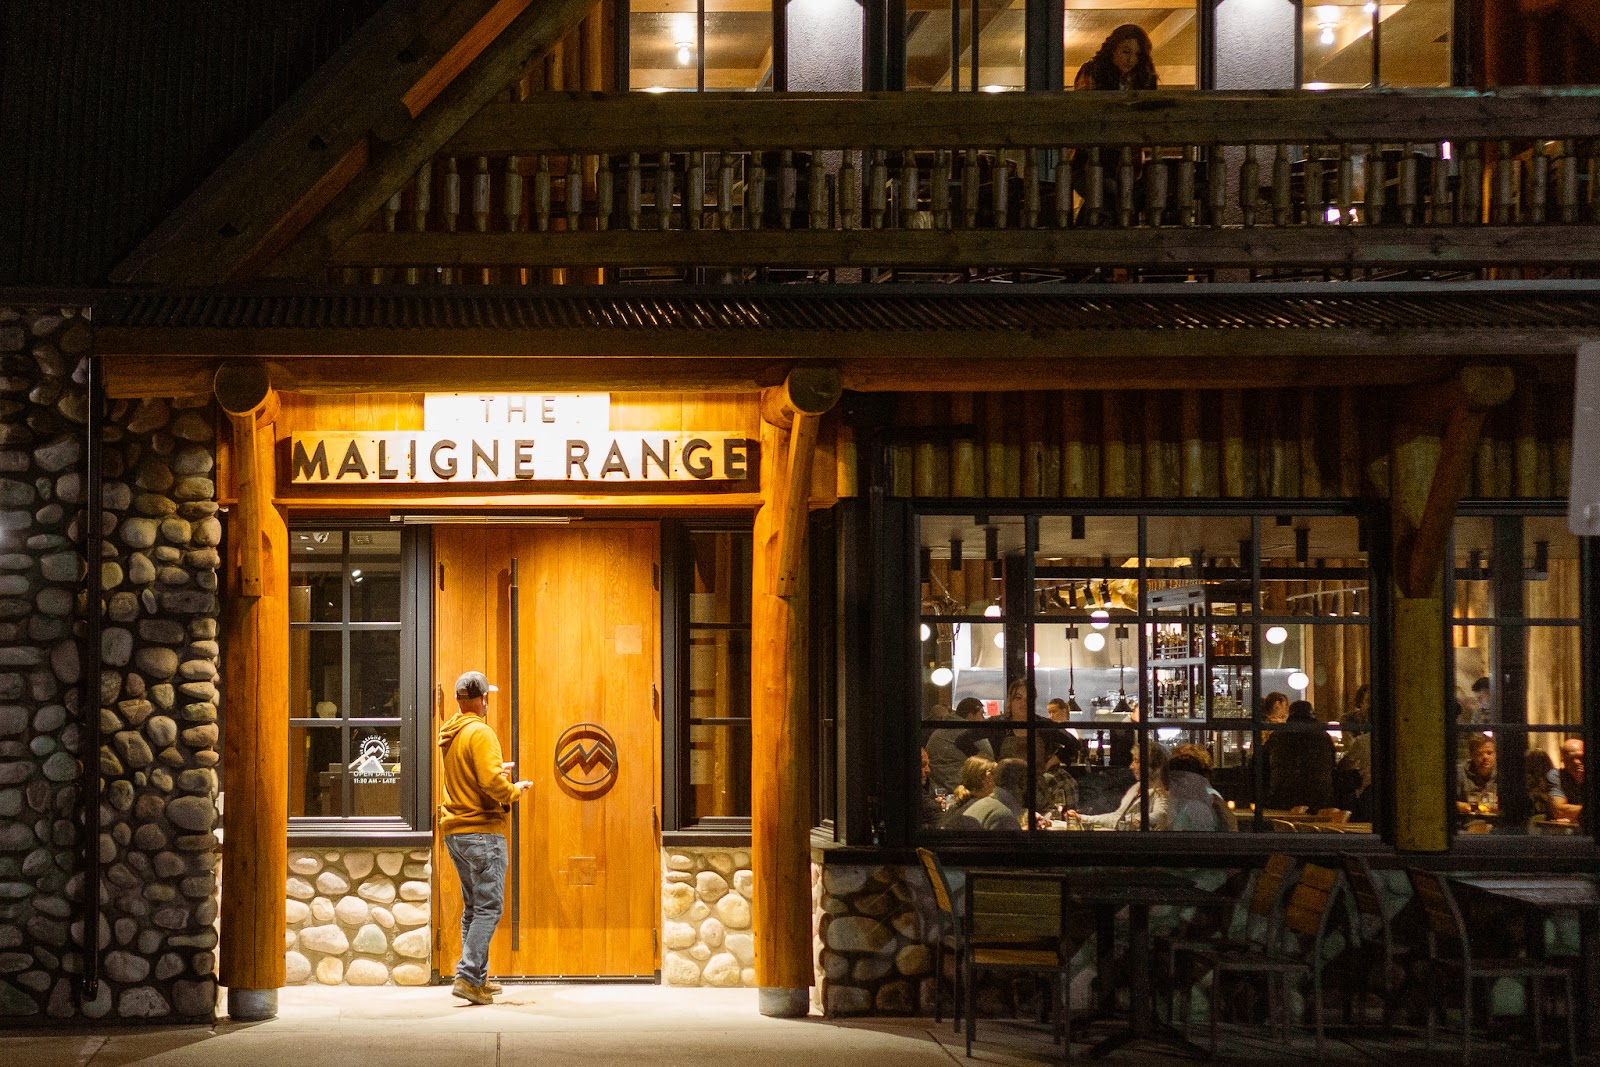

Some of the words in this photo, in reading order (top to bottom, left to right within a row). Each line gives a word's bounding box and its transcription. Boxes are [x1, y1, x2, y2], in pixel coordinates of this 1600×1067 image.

[479, 395, 557, 423] THE
[291, 438, 536, 480] MALIGNE
[565, 438, 748, 480] RANGE
[360, 735, 382, 749] MALIGNE
[381, 738, 390, 758] RANGE
